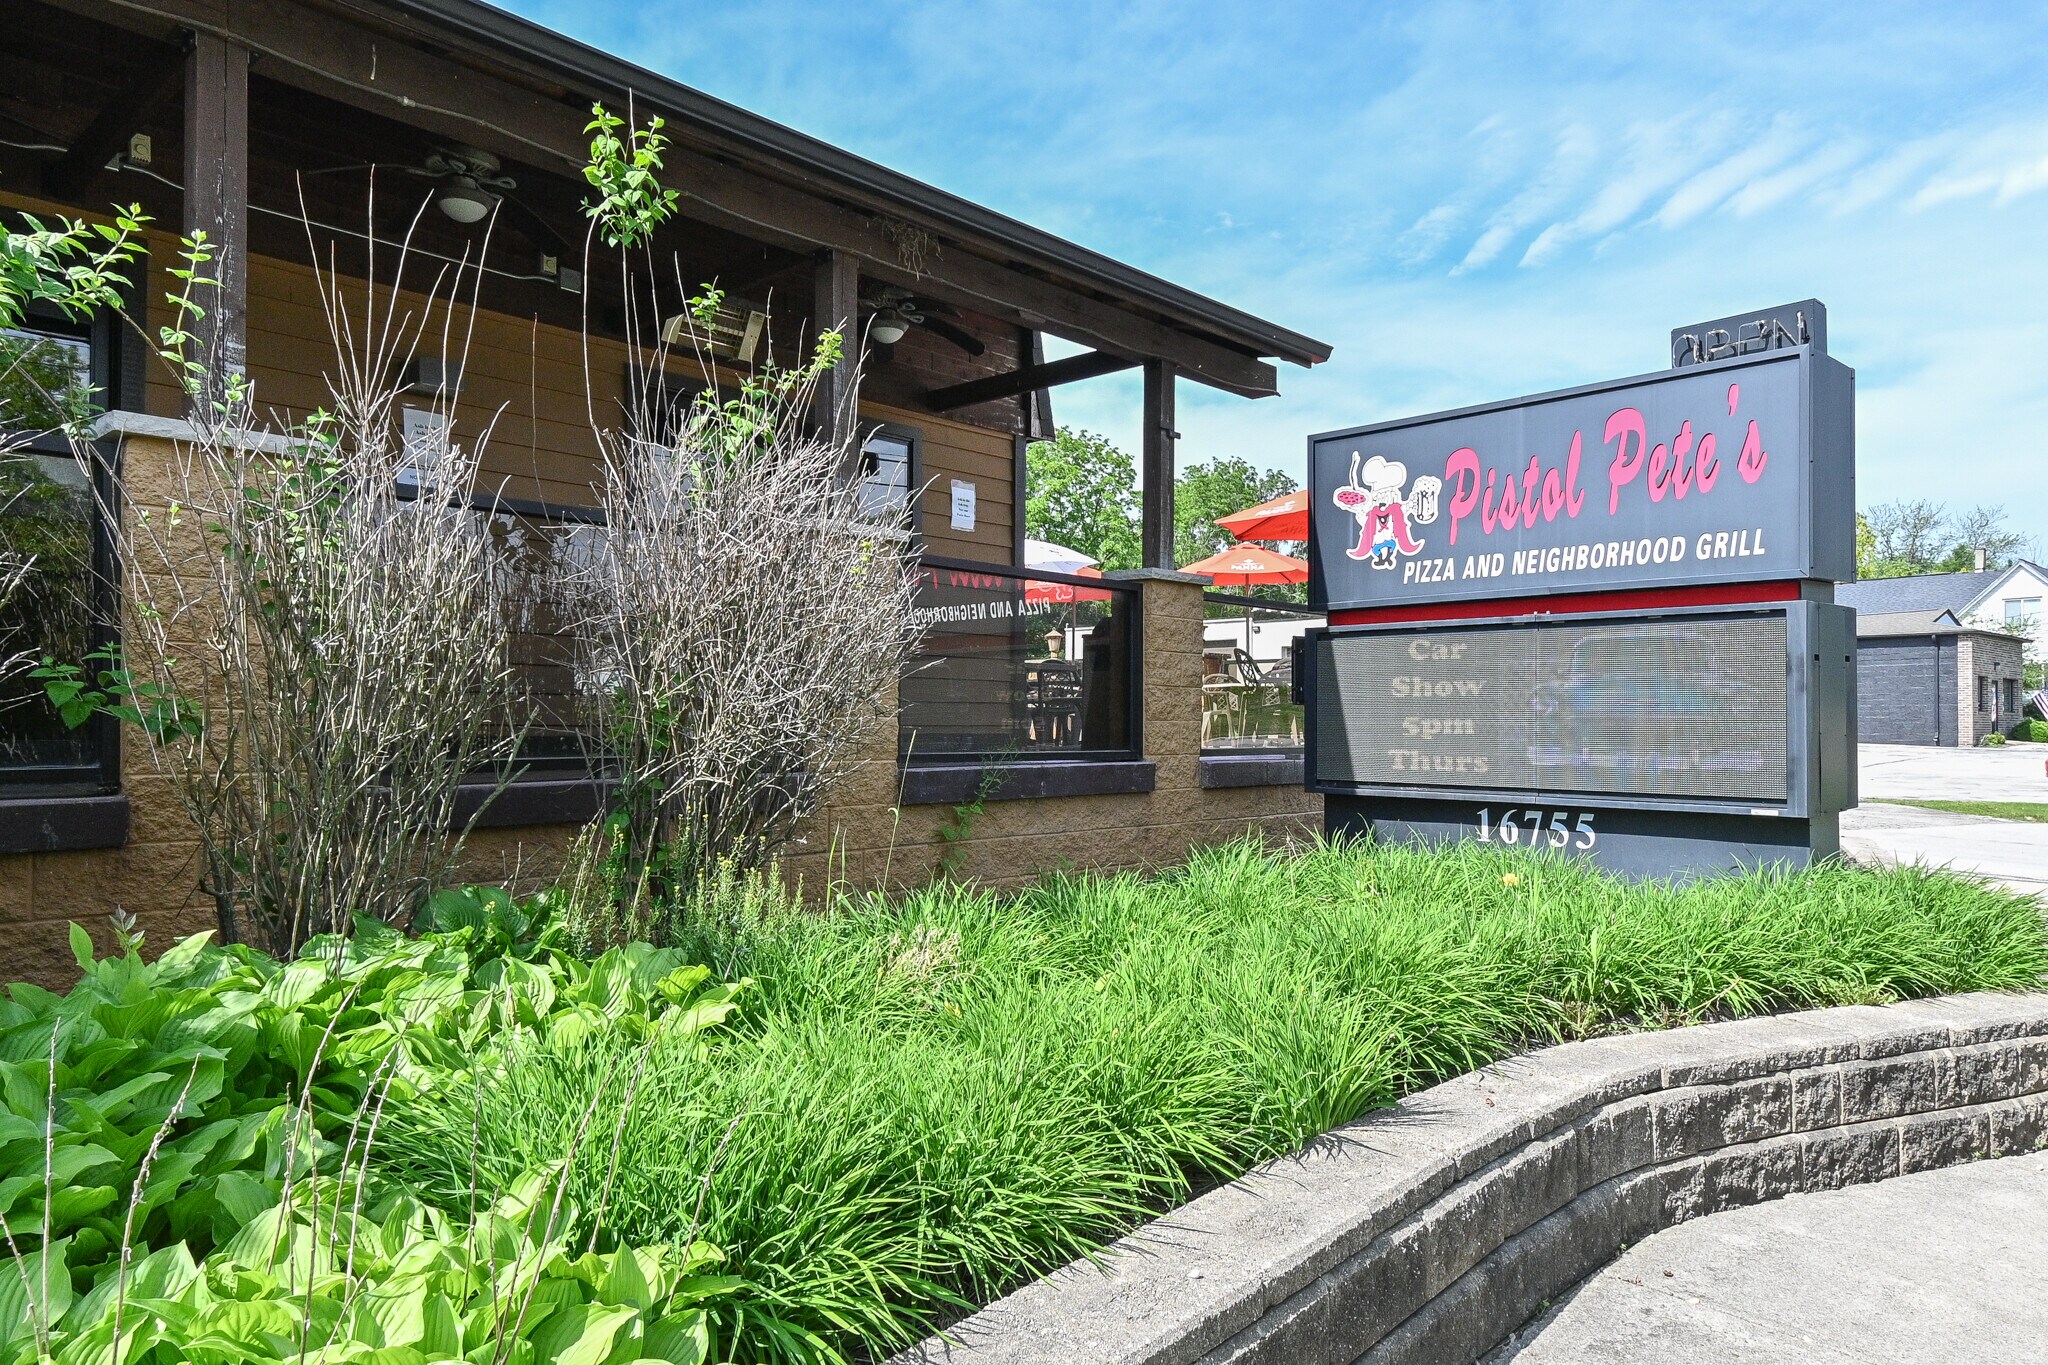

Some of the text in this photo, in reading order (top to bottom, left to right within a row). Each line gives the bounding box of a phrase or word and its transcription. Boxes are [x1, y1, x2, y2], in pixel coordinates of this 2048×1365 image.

[1444, 383, 1768, 546] Pistol Pete's
[1403, 528, 1766, 584] PIZZA AND NEIGHBORHOOD GRILL
[1408, 639, 1468, 661] Car
[1391, 676, 1487, 698] Show
[1387, 749, 1489, 773] Thurs
[1476, 807, 1596, 850] 16755
